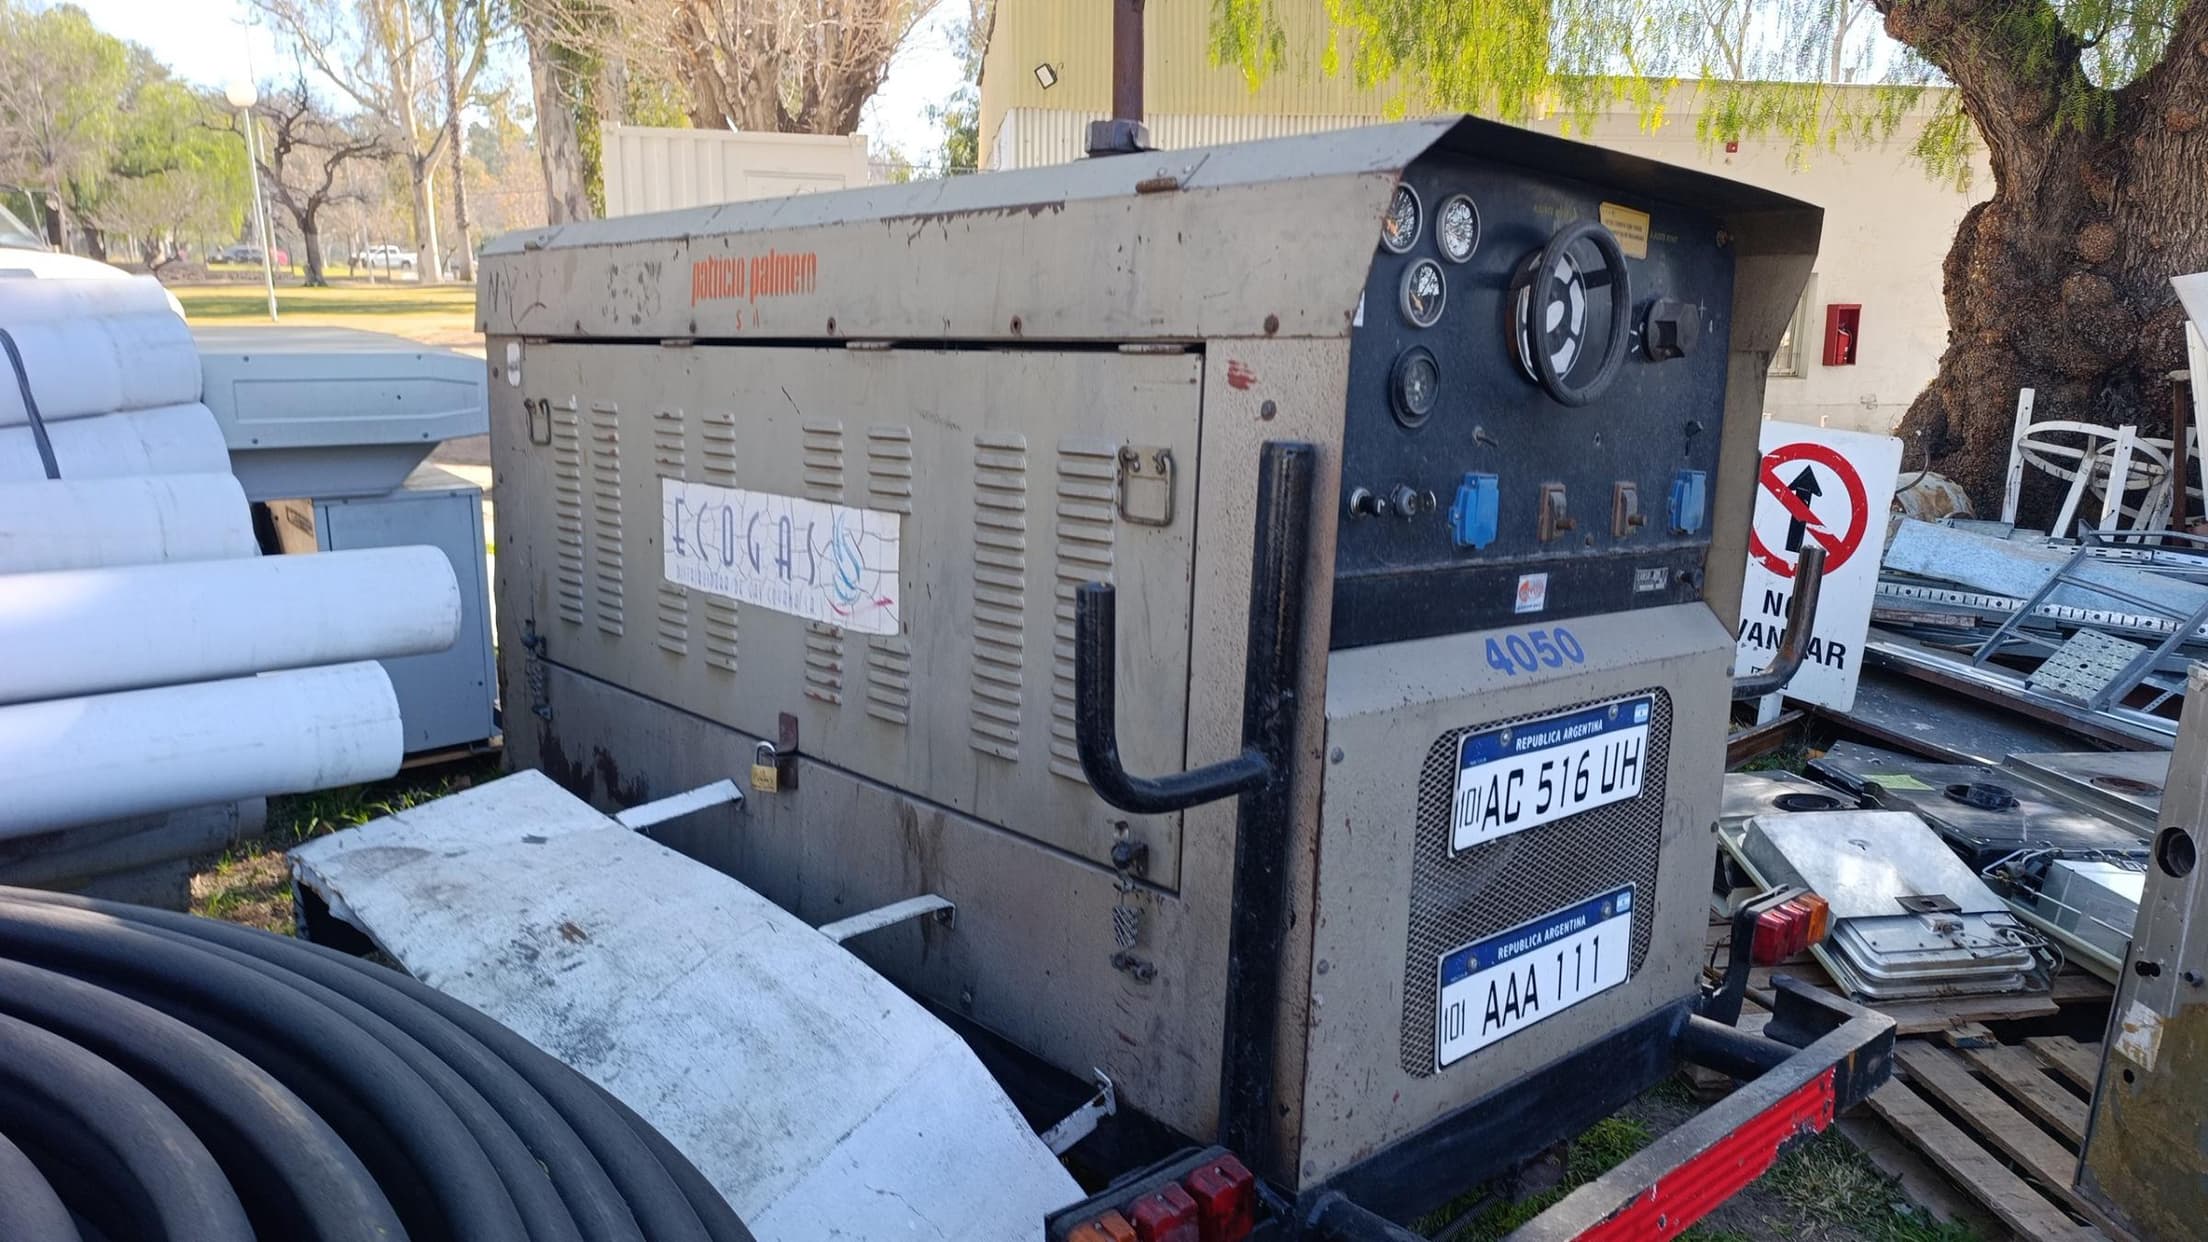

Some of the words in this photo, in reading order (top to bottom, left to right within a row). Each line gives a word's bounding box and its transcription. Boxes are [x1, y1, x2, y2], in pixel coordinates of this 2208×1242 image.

[672, 498, 816, 586] ECOGAS
[1485, 627, 1585, 677] 4050
[1516, 730, 1561, 752] REPUBLICA
[1563, 719, 1603, 741] ARGENTINA
[1481, 768, 1524, 832] AC
[1536, 749, 1590, 815] 516
[1601, 736, 1641, 794] UH
[1497, 934, 1543, 961] REPUBLICA
[1544, 914, 1587, 943] ARGENTINA
[1482, 962, 1539, 1036] AAA
[1557, 934, 1600, 1001] 111
